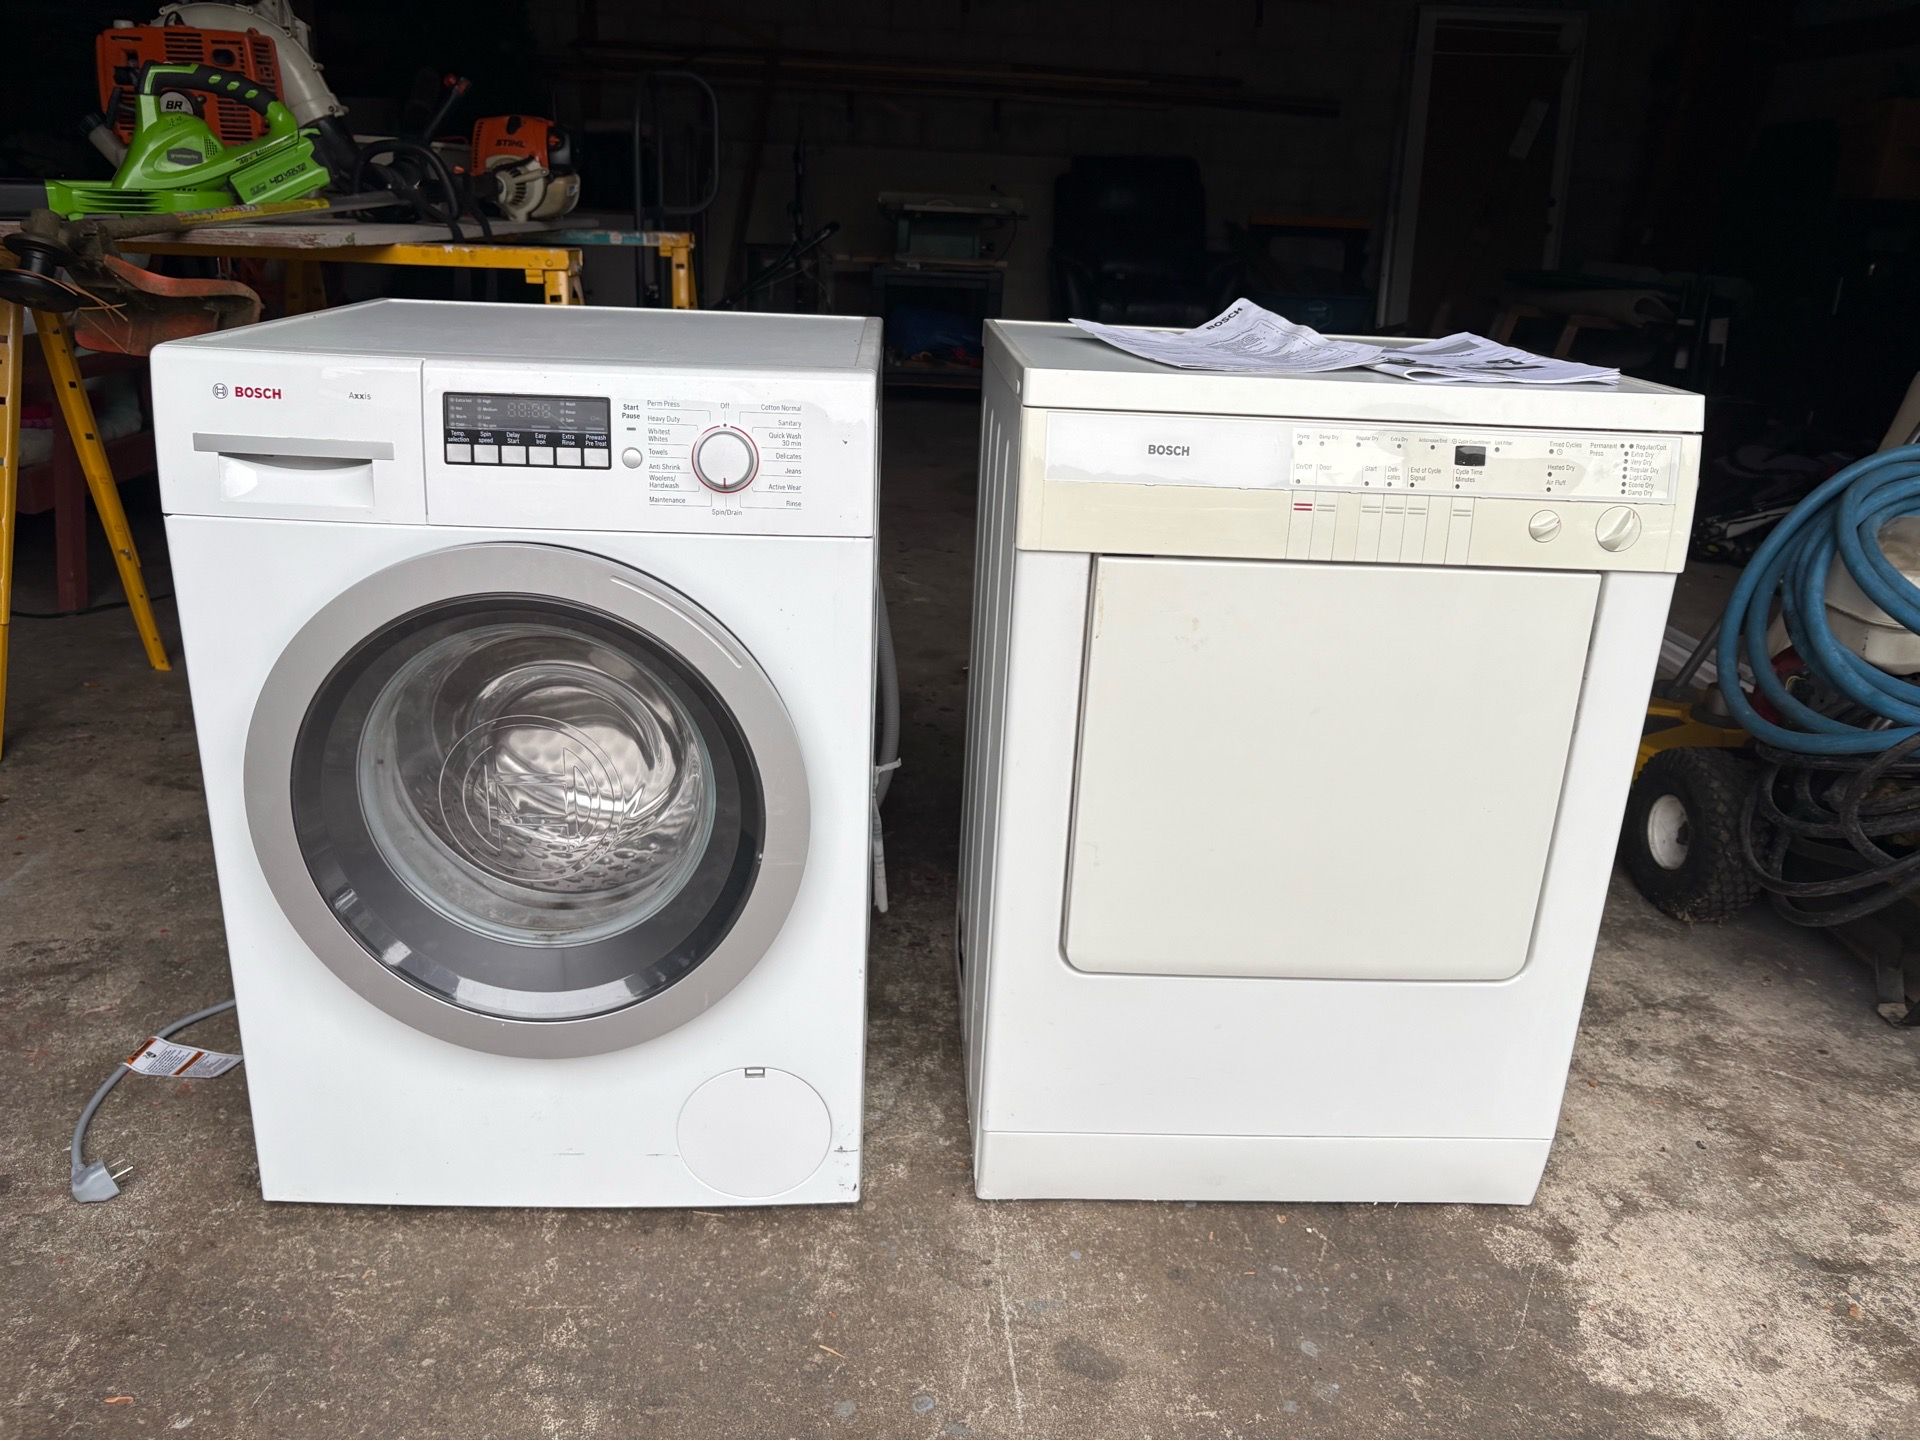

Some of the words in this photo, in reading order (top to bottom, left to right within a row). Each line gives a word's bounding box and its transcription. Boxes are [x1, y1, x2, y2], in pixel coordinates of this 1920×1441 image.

[166, 100, 183, 110] BR
[496, 139, 525, 148] STIHL
[1206, 307, 1243, 330] BOSCH
[235, 386, 282, 399] BOSCH
[348, 391, 371, 400] Axxis
[623, 403, 639, 411] Start
[648, 415, 665, 423] Heavy
[666, 416, 680, 424] Duty
[778, 419, 801, 428] Sanitary
[451, 430, 465, 438] Temp.
[648, 428, 670, 436] Whitest
[768, 432, 786, 440] Quick
[648, 435, 668, 443] Whites
[1566, 441, 1582, 449] Cycles
[649, 448, 668, 456] Towels
[1147, 444, 1190, 457] BOSCH
[1644, 451, 1654, 459] Dry
[1630, 458, 1642, 466] Very
[1566, 464, 1575, 472] Dry
[1629, 466, 1649, 474] Regular
[1650, 466, 1659, 475] Dry
[649, 474, 676, 483] Woolens/
[1410, 474, 1426, 482] Signal
[1629, 474, 1641, 482] Light
[1642, 474, 1653, 482] Dry
[1644, 482, 1655, 490] Dry
[1627, 489, 1642, 497] Damp
[1643, 489, 1653, 497] Dry
